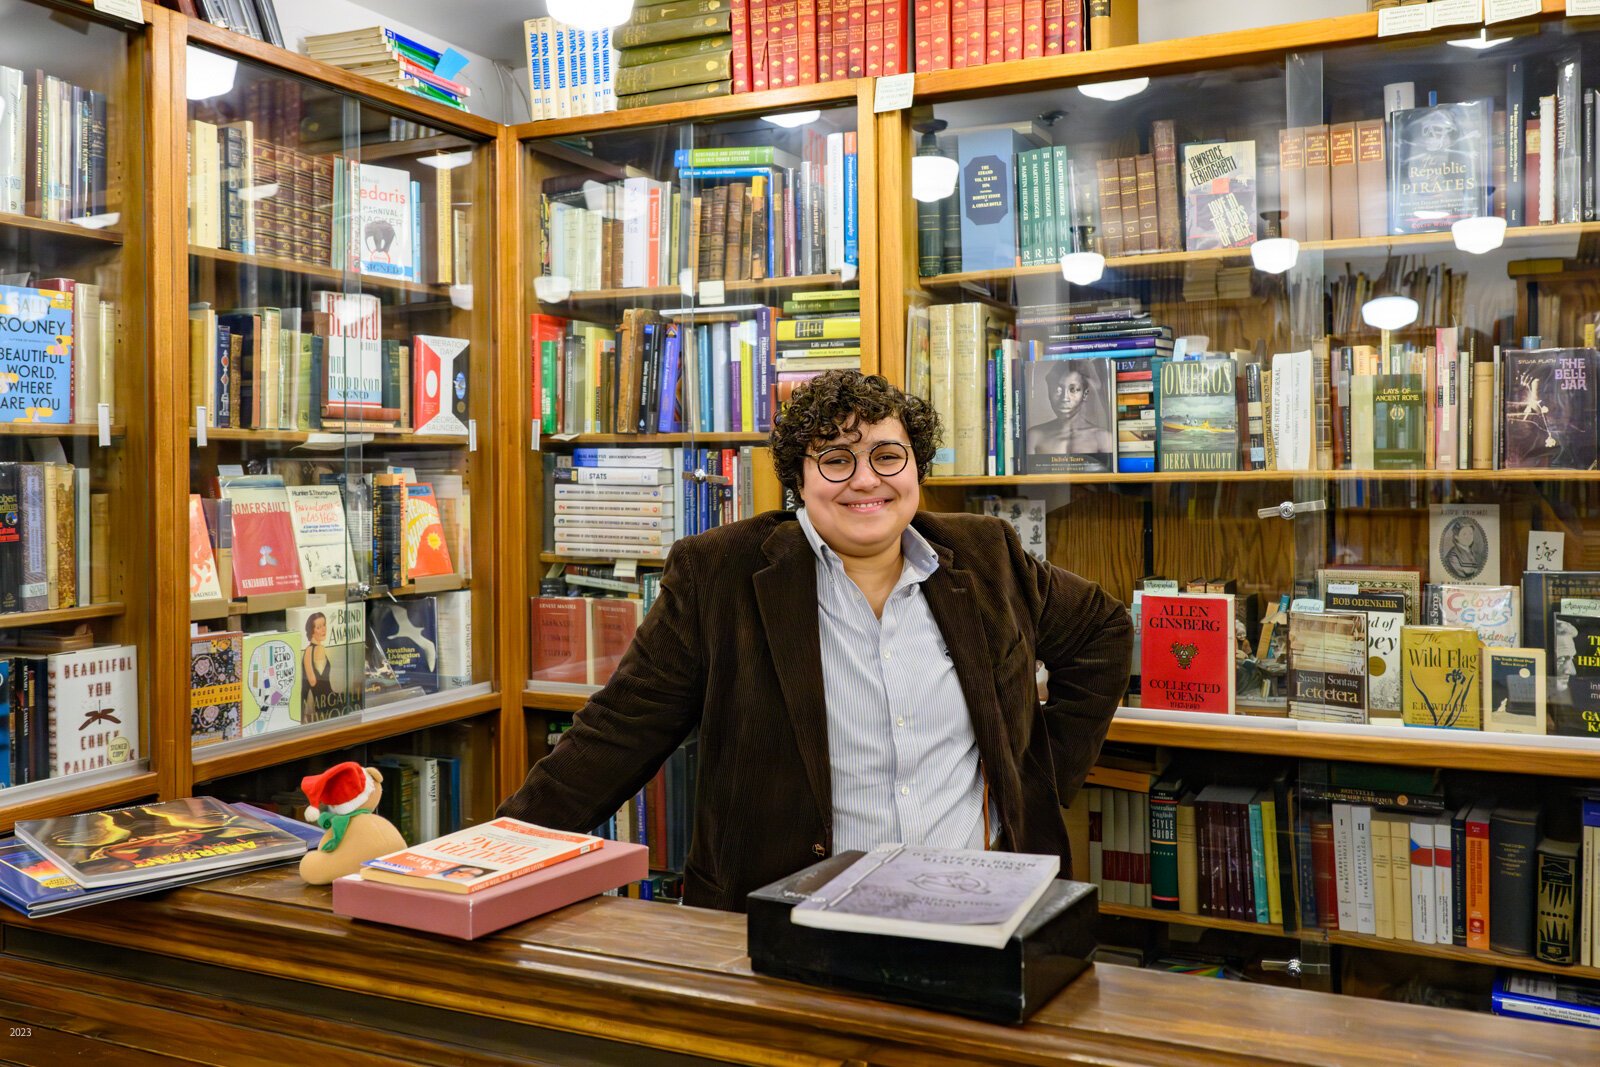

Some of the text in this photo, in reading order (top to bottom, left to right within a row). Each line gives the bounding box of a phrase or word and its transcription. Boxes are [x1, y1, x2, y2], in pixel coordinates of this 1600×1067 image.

[1043, 161, 1051, 184] MARTIN
[1057, 160, 1065, 183] MARTIN
[1410, 161, 1467, 178] Republic
[1402, 177, 1475, 195] PIRATES
[1044, 184, 1052, 217] HEIDEGGER
[1058, 183, 1066, 216] HEIDEGGER
[0, 318, 66, 335] ROONEY
[1559, 358, 1586, 369] THE
[7, 364, 57, 380] WORLD,
[1165, 362, 1232, 395] OMEROS
[1555, 368, 1586, 380] BELL
[9, 381, 53, 395] WHERE
[1561, 379, 1587, 391] JAR
[1, 396, 60, 411] ARE YOU
[1376, 394, 1401, 402] ANCIENT
[1164, 452, 1232, 470] DEREK WALCOTT
[231, 501, 286, 515] SOMERSAULT
[1332, 597, 1398, 609] BOB ODENKIRK
[1160, 605, 1209, 618] ALLEN
[1149, 617, 1220, 632] GINSBERG
[1382, 616, 1397, 632] of
[1412, 632, 1441, 645] The
[274, 652, 291, 665] KIND
[1409, 647, 1477, 673] Wild Flag
[276, 667, 295, 680] FUNNY
[1298, 672, 1359, 688] Susan Sontag
[1149, 679, 1221, 694] COLLECTED
[1165, 690, 1205, 703] POEMS
[1152, 818, 1174, 830] STYLE
[1152, 829, 1174, 839] GUIDE
